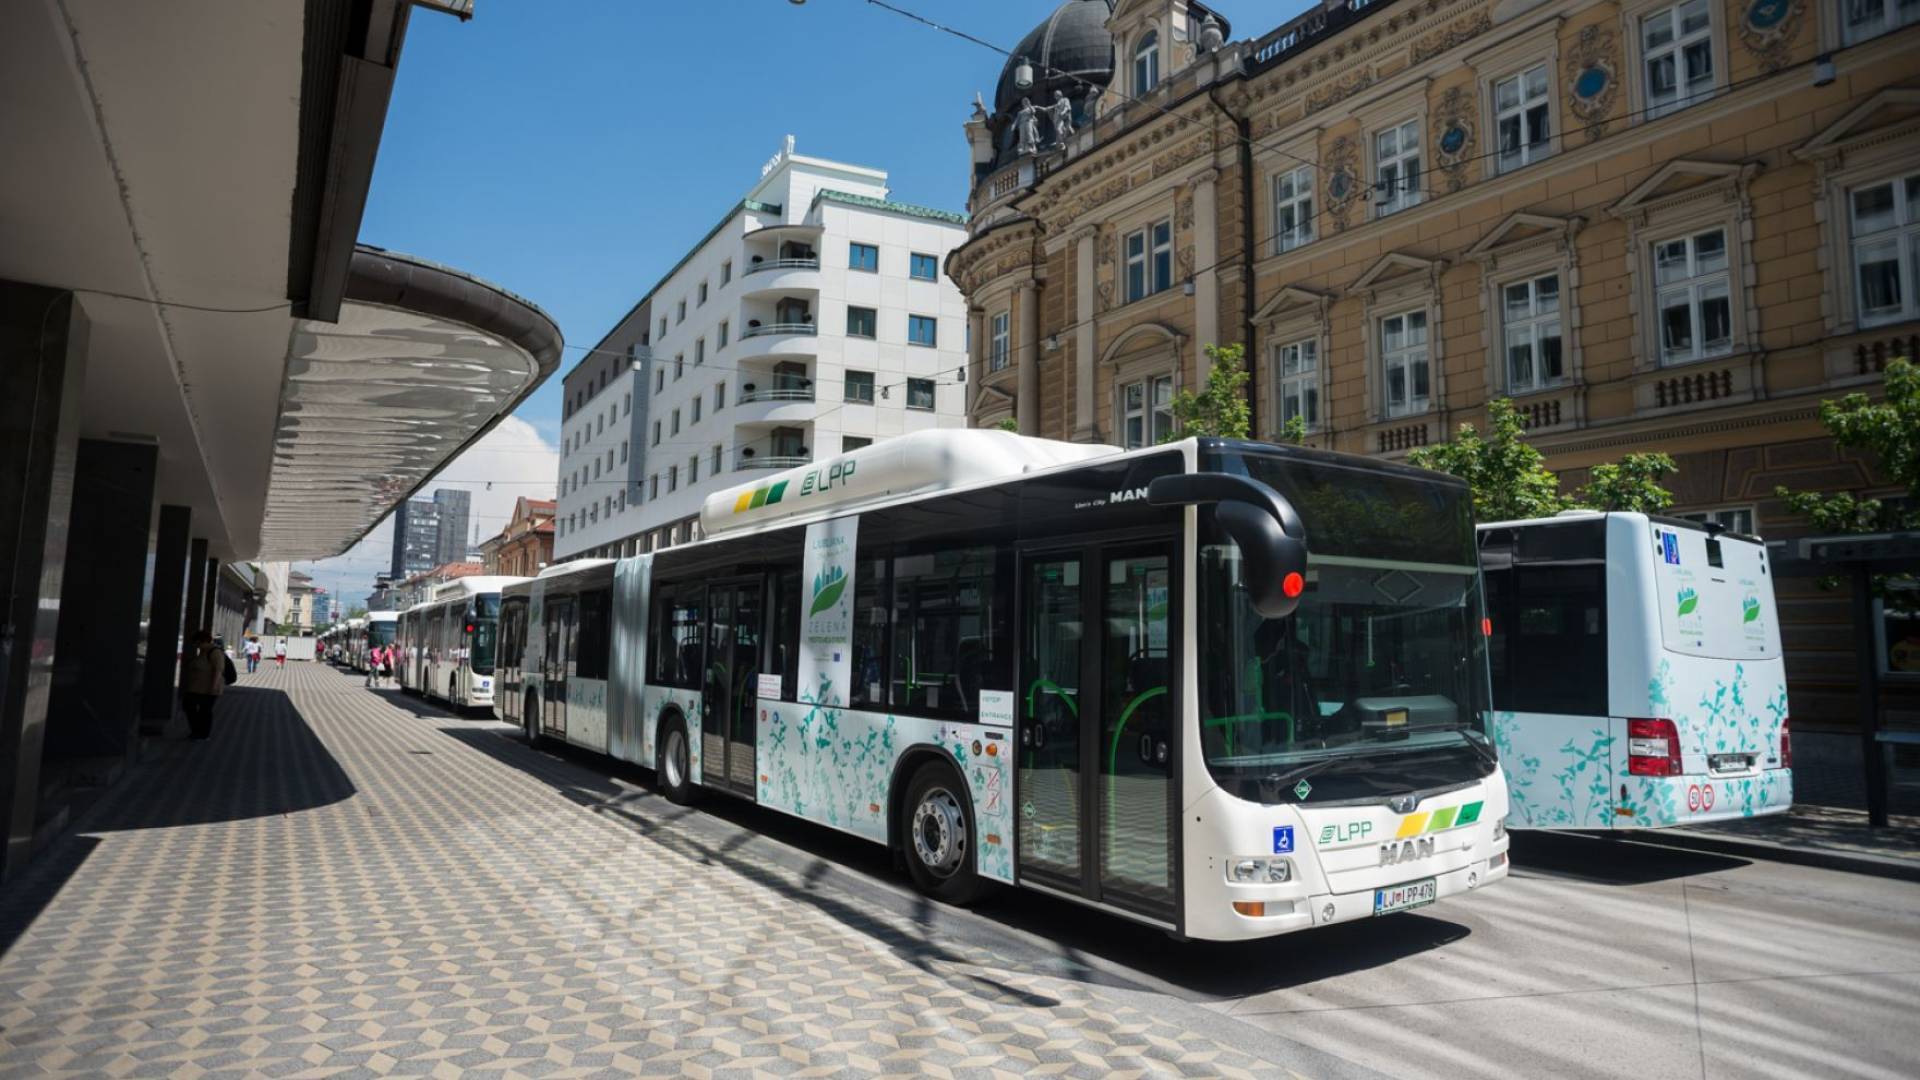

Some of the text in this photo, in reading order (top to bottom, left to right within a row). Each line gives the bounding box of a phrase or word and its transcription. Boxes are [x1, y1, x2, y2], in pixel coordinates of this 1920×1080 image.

[818, 460, 856, 491] LPP
[1110, 487, 1149, 503] MAN
[808, 621, 847, 633] ZELENA
[1337, 821, 1373, 842] LPP
[1379, 836, 1435, 867] MAN
